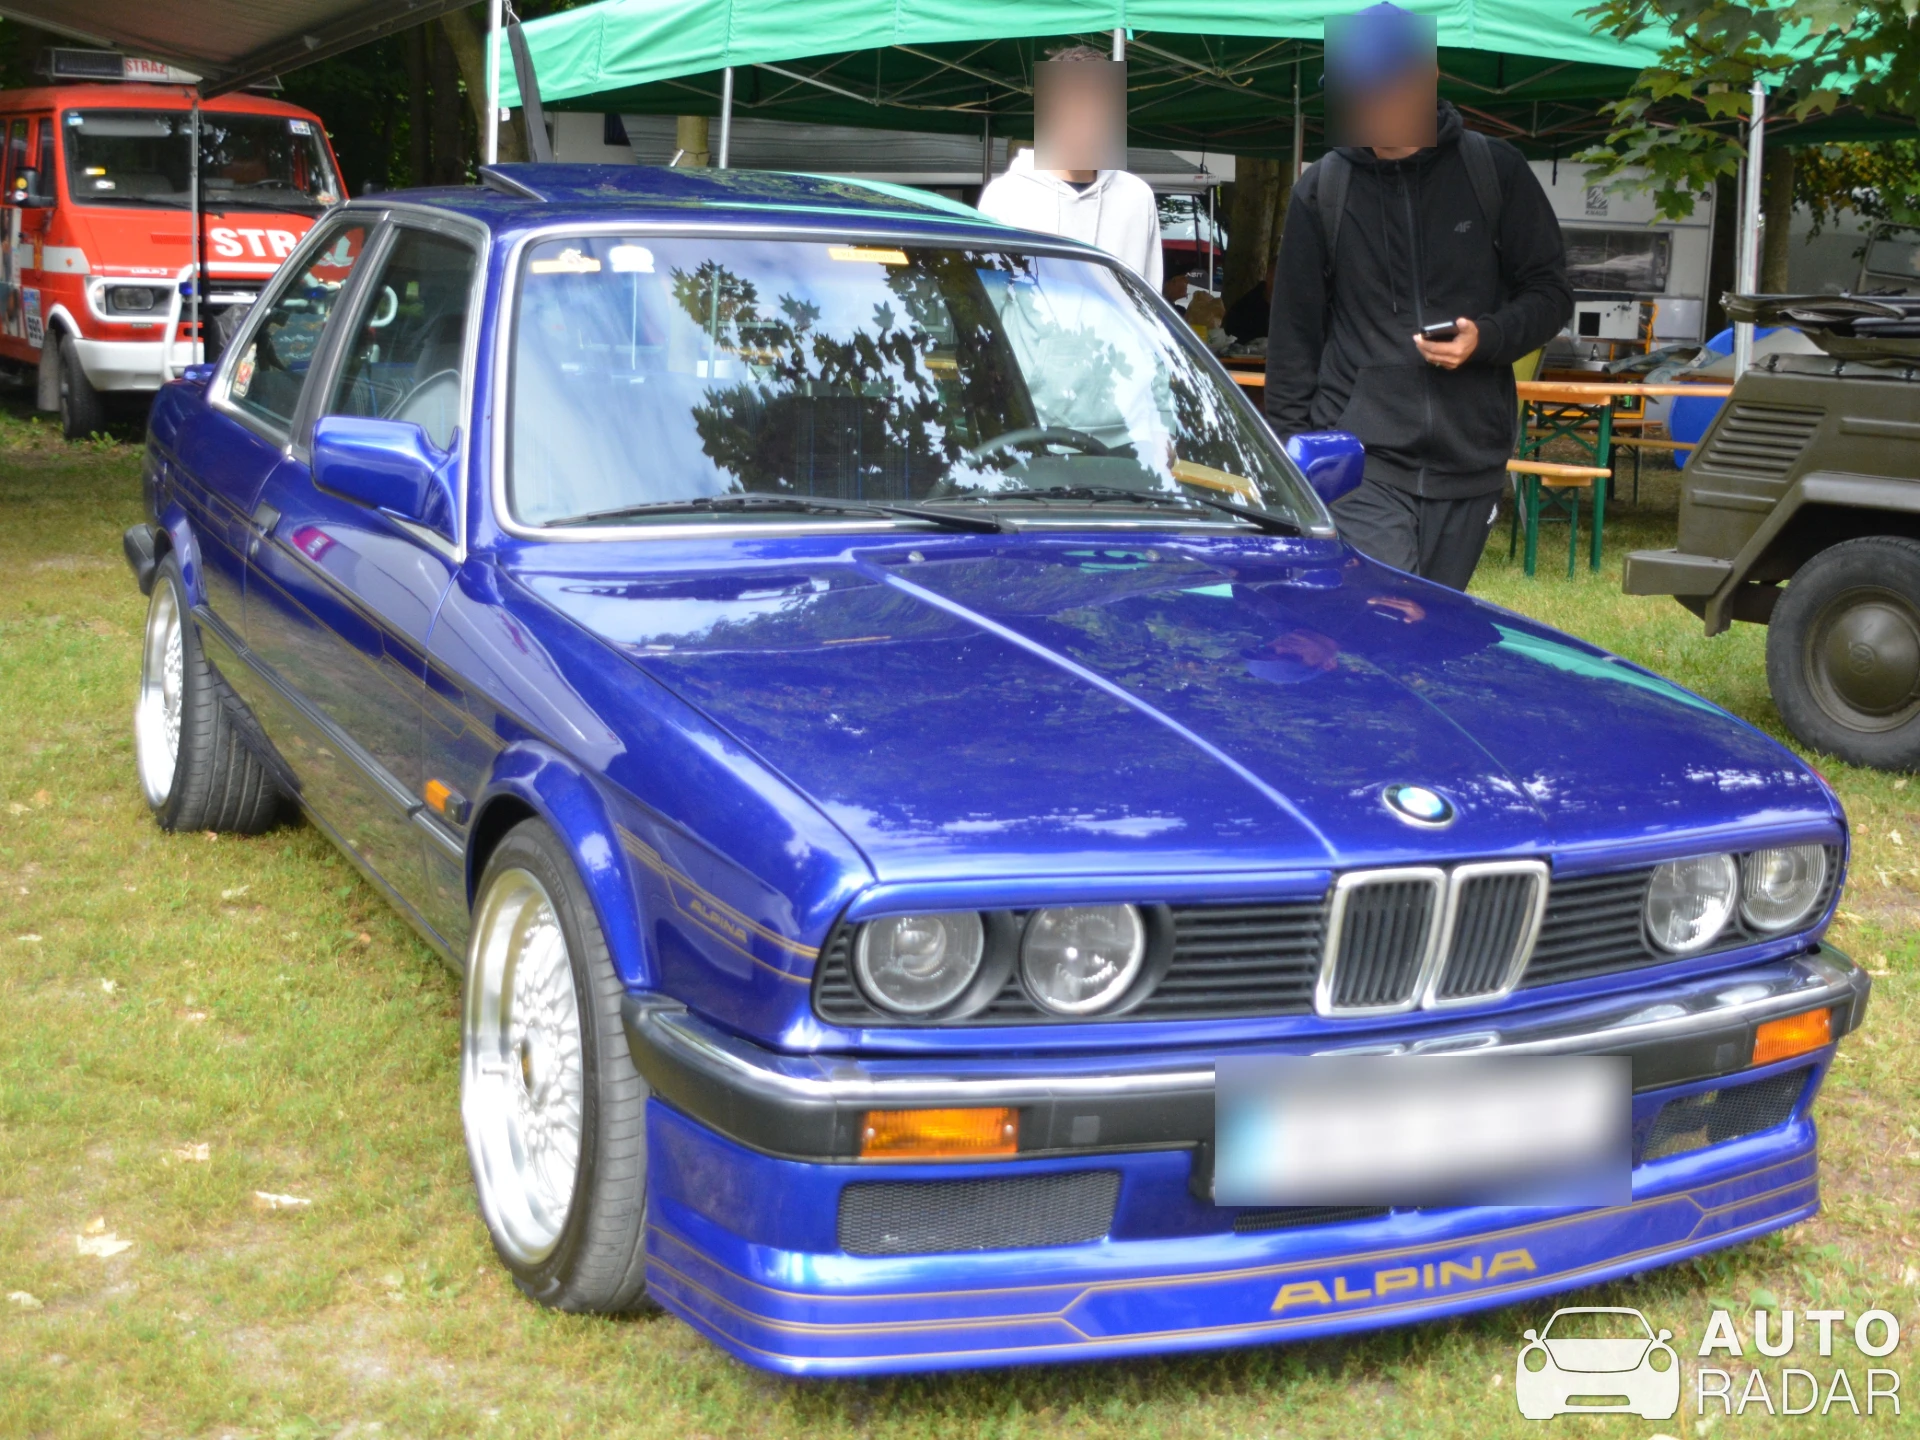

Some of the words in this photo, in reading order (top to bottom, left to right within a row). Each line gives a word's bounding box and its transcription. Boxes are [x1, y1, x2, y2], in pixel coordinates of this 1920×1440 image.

[210, 228, 307, 258] STR
[690, 900, 747, 943] ALPINA
[1270, 1248, 1537, 1311] ALPINA
